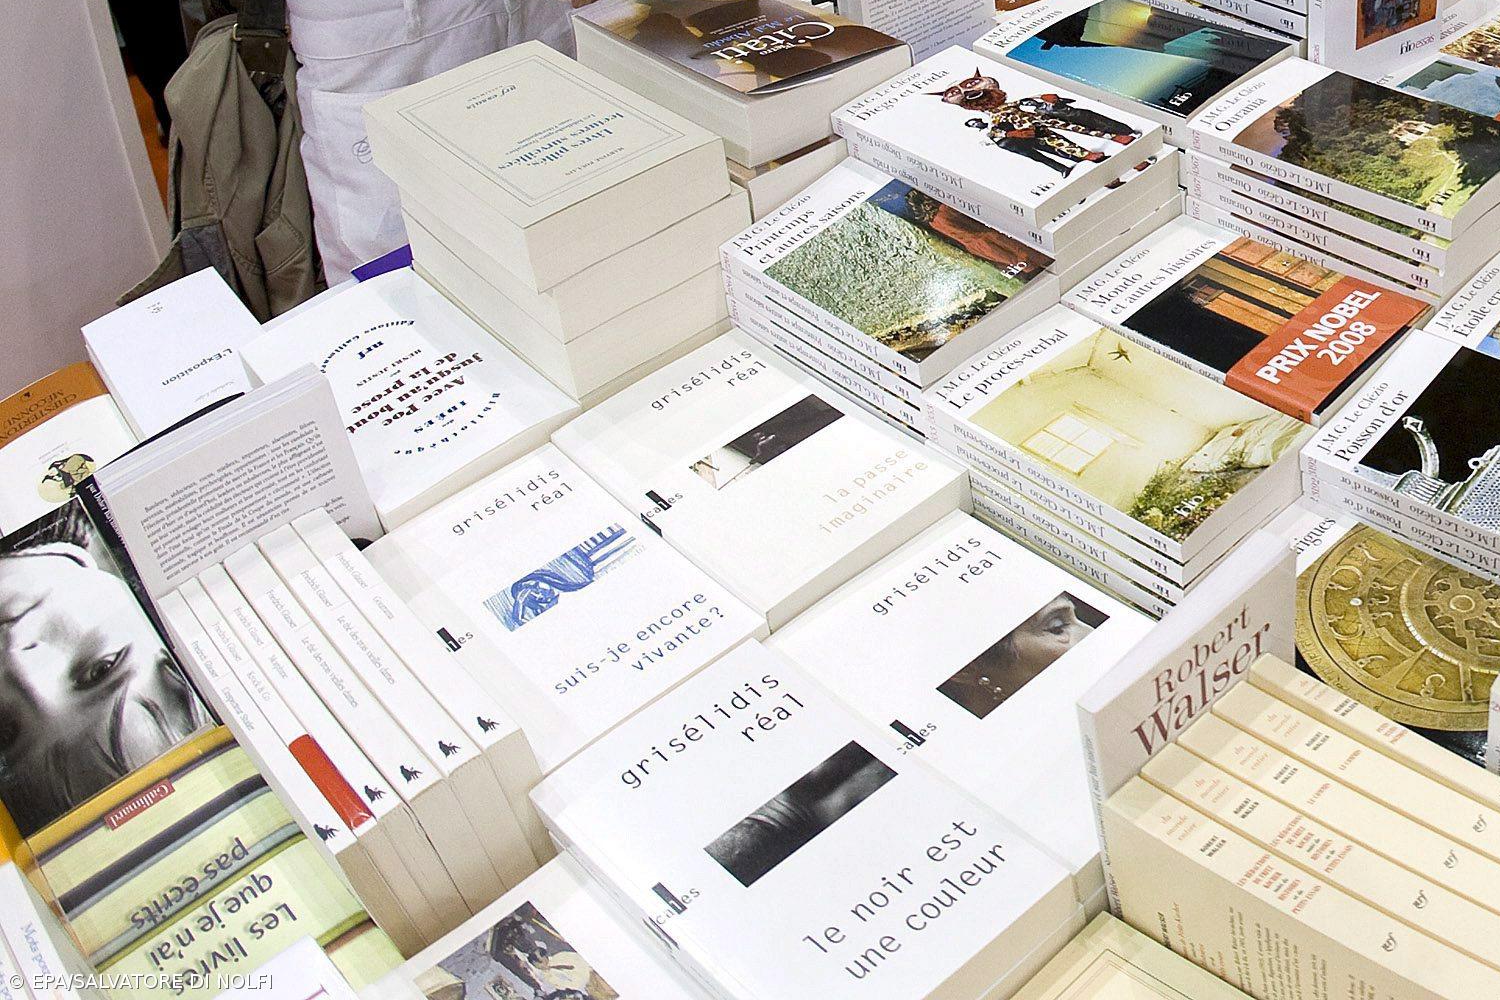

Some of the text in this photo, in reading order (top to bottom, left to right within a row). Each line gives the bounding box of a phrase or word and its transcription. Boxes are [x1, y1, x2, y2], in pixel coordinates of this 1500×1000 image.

[709, 20, 836, 64] Citati
[855, 69, 951, 123] Diego et Frida
[1214, 95, 1267, 133] Ourania
[571, 127, 613, 149] Livres
[742, 209, 816, 257] Printemps
[758, 188, 867, 265] et autres saisons
[1090, 271, 1144, 308] Mondo
[1109, 238, 1218, 316] et autres histoires
[1256, 288, 1382, 386] PRIX NOBEL
[1316, 319, 1378, 367] 2008
[1452, 303, 1491, 339] Étoile
[159, 346, 234, 388] L'Exposition
[345, 351, 484, 435] jusqu'au bout
[349, 351, 458, 415] de la prose
[381, 376, 465, 427] Avec Poe
[649, 346, 755, 414] grisélidis
[724, 359, 769, 391] réal
[948, 327, 1070, 411] Le procès-verbal
[1333, 389, 1410, 463] Poisson d'or
[450, 466, 562, 539] grisélidis
[529, 481, 575, 515] réal
[818, 458, 930, 536] imaginaire
[870, 534, 984, 617] grisélidis
[956, 548, 1005, 586] réal
[551, 591, 709, 697] suis-je encore
[629, 606, 727, 674] vivante?
[1149, 602, 1252, 704] Robert
[739, 691, 806, 744] réal
[1130, 619, 1272, 762] Walser
[619, 670, 782, 791] grisélidis
[129, 836, 250, 931] pas écrits
[801, 816, 980, 956] le noir est
[843, 840, 1009, 982] une couleur
[148, 872, 273, 972] que je n'ai
[166, 902, 298, 997] Les livres
